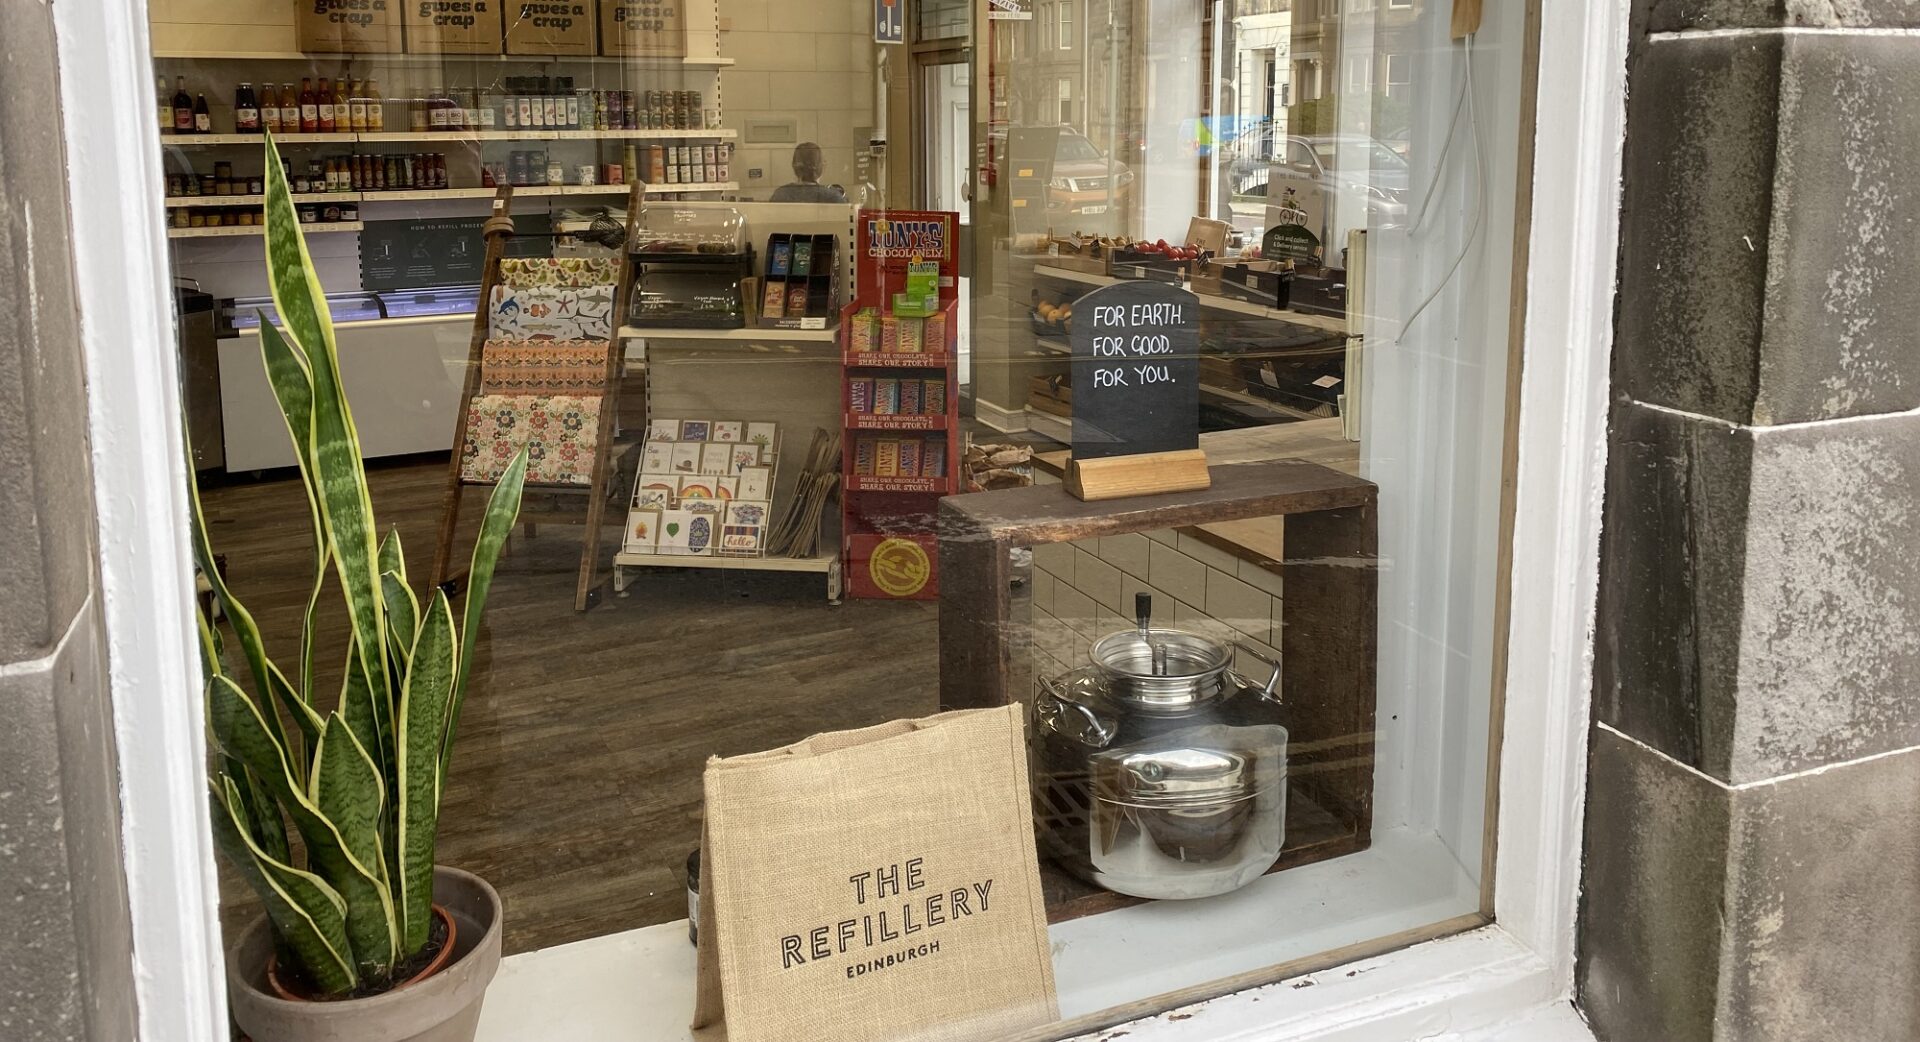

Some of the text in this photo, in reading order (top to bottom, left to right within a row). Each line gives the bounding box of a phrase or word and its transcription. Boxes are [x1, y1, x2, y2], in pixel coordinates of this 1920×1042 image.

[419, 1, 488, 17] gives a
[519, 4, 585, 19] gives a
[614, 7, 660, 22] gives
[328, 12, 373, 28] crap
[433, 15, 475, 29] crap
[533, 17, 573, 32] crap
[626, 20, 664, 34] crap
[1093, 302, 1186, 327] FOR EARTH.
[1093, 334, 1174, 357] FOR GOOD.
[1093, 364, 1176, 388] FOR YOU.
[727, 535, 752, 547] hello
[849, 857, 925, 904] THE
[781, 879, 993, 969] REFILLERY
[846, 940, 940, 979] EDINBURGH
